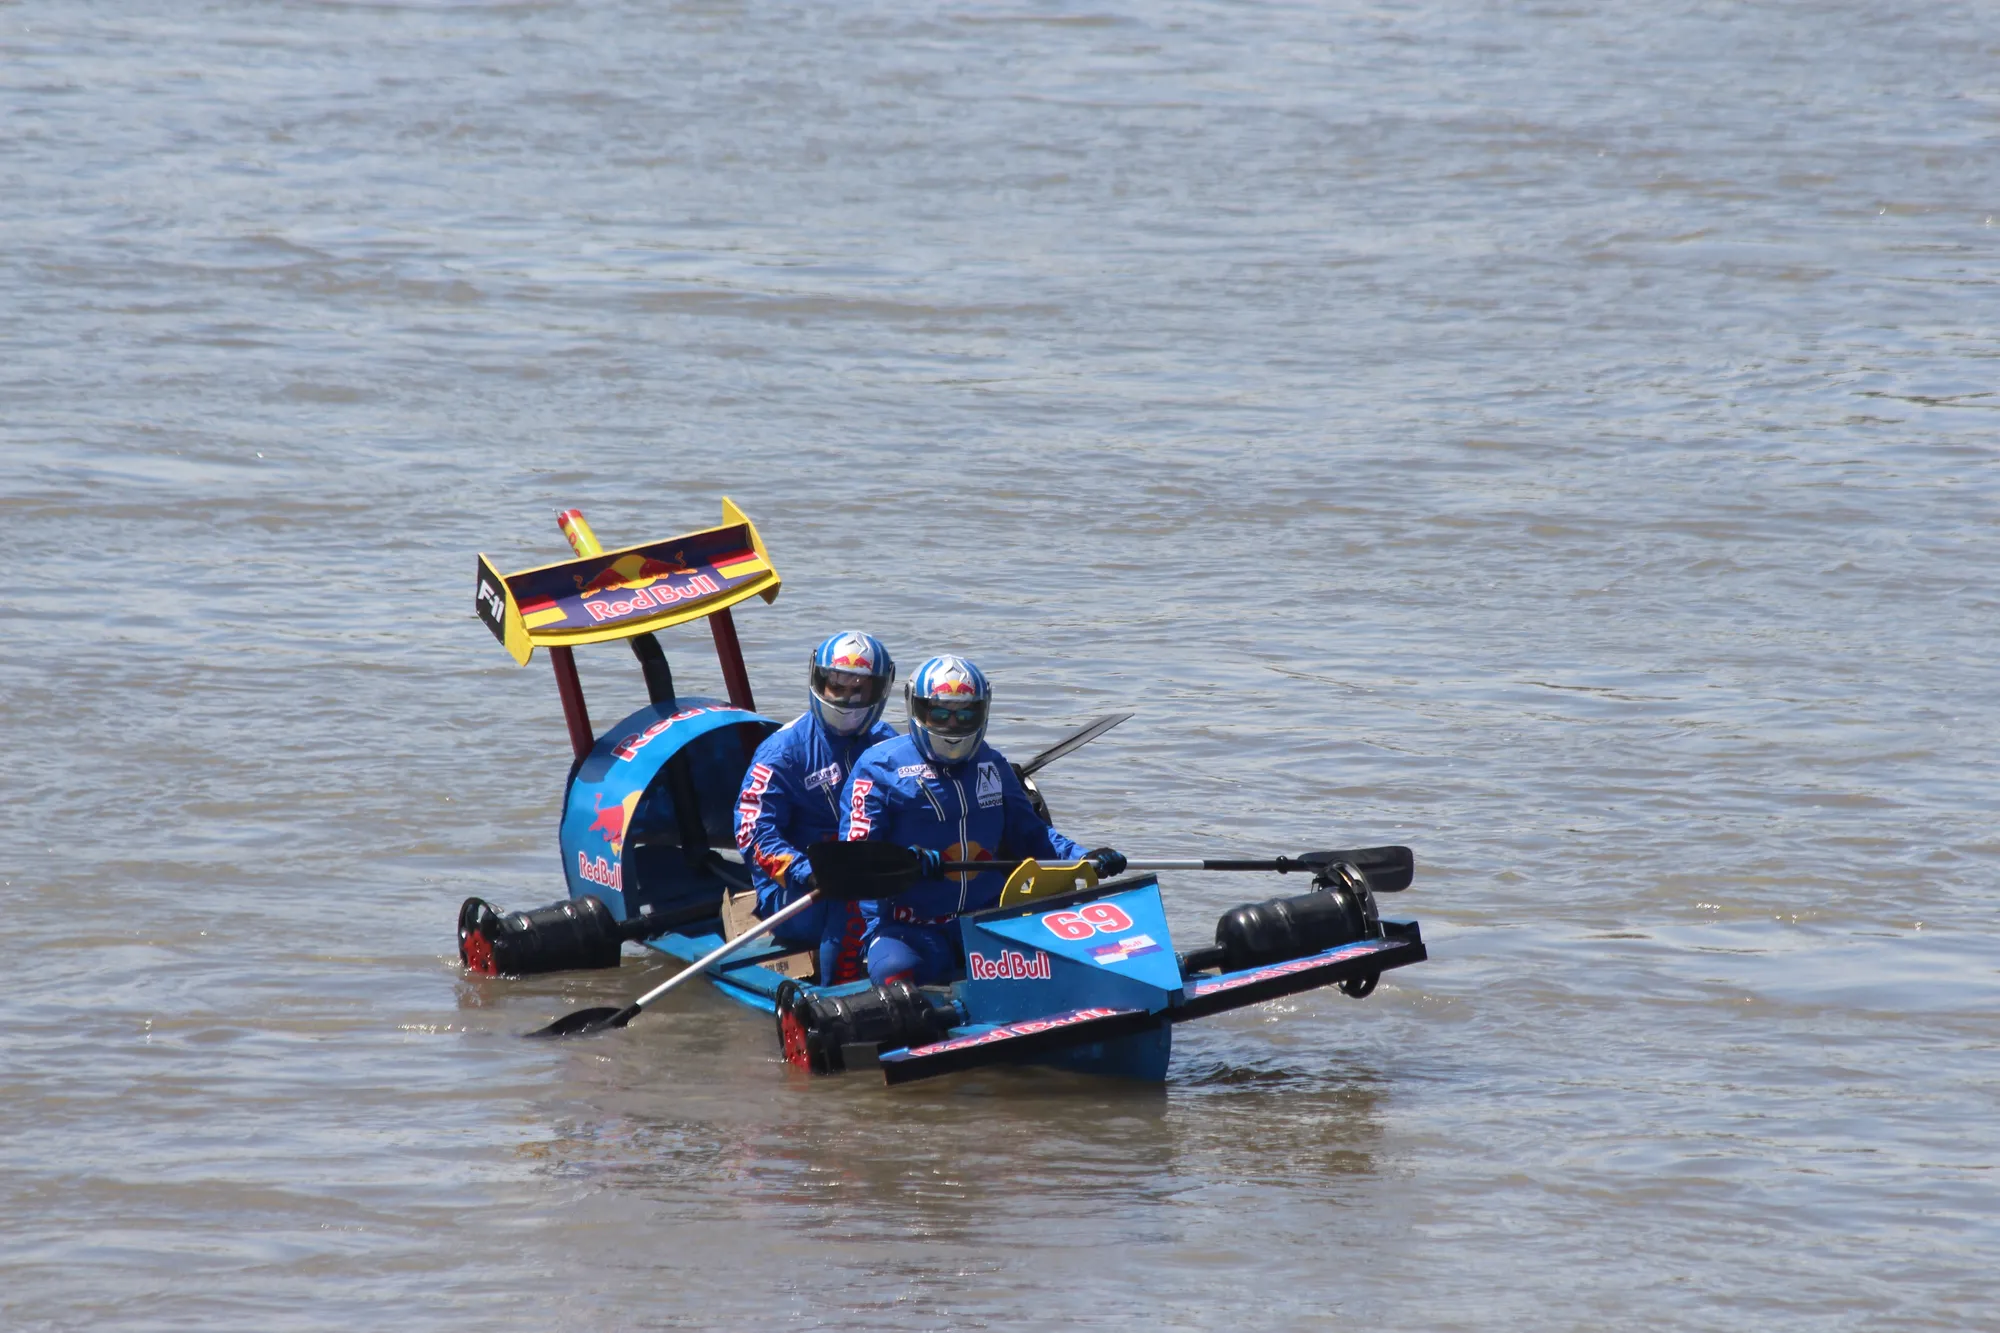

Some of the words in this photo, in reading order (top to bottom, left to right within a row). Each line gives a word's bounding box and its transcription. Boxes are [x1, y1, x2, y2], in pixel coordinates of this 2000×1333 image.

[584, 590, 658, 622] Red
[652, 574, 720, 605] Bull
[739, 762, 774, 806] Bull
[851, 779, 874, 826] Red
[735, 807, 761, 849] Red
[578, 851, 600, 882] Red
[599, 855, 622, 892] Bull
[1042, 903, 1133, 940] 69
[969, 950, 1011, 981] Red
[1011, 951, 1051, 980] Bull
